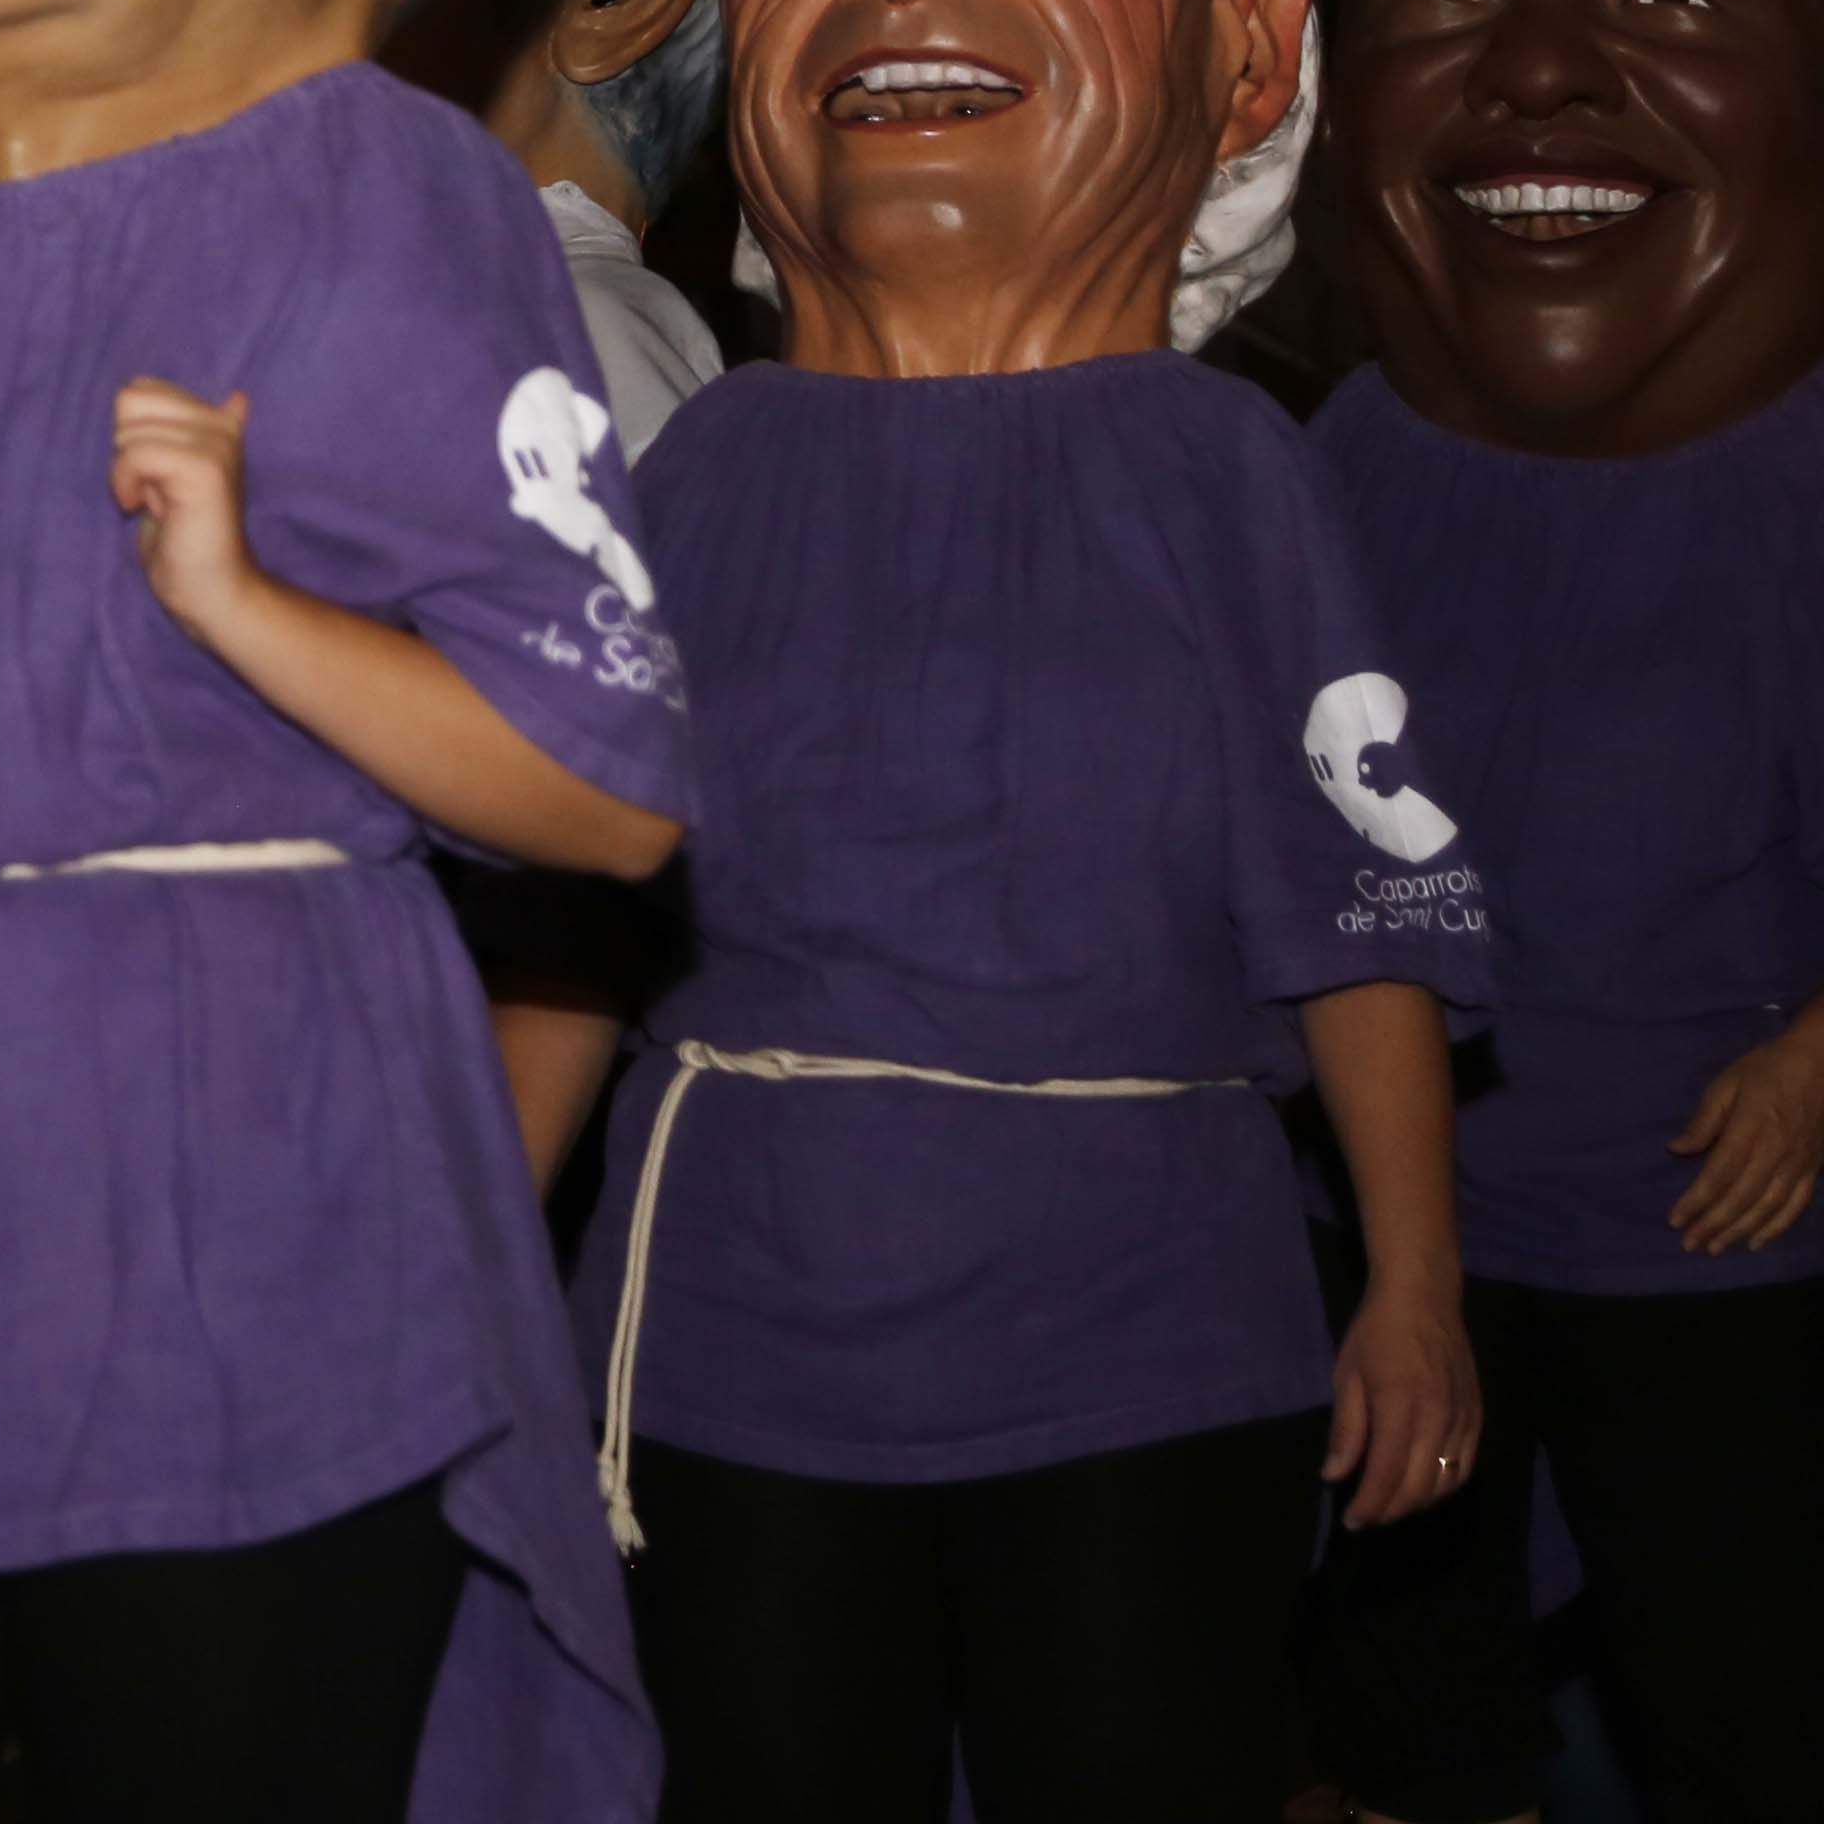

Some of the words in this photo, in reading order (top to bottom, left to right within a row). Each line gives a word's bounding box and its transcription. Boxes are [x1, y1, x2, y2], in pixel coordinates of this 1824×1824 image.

[1355, 864, 1483, 902] Caparrots
[1337, 901, 1376, 933] de
[1385, 904, 1432, 930] Sant
